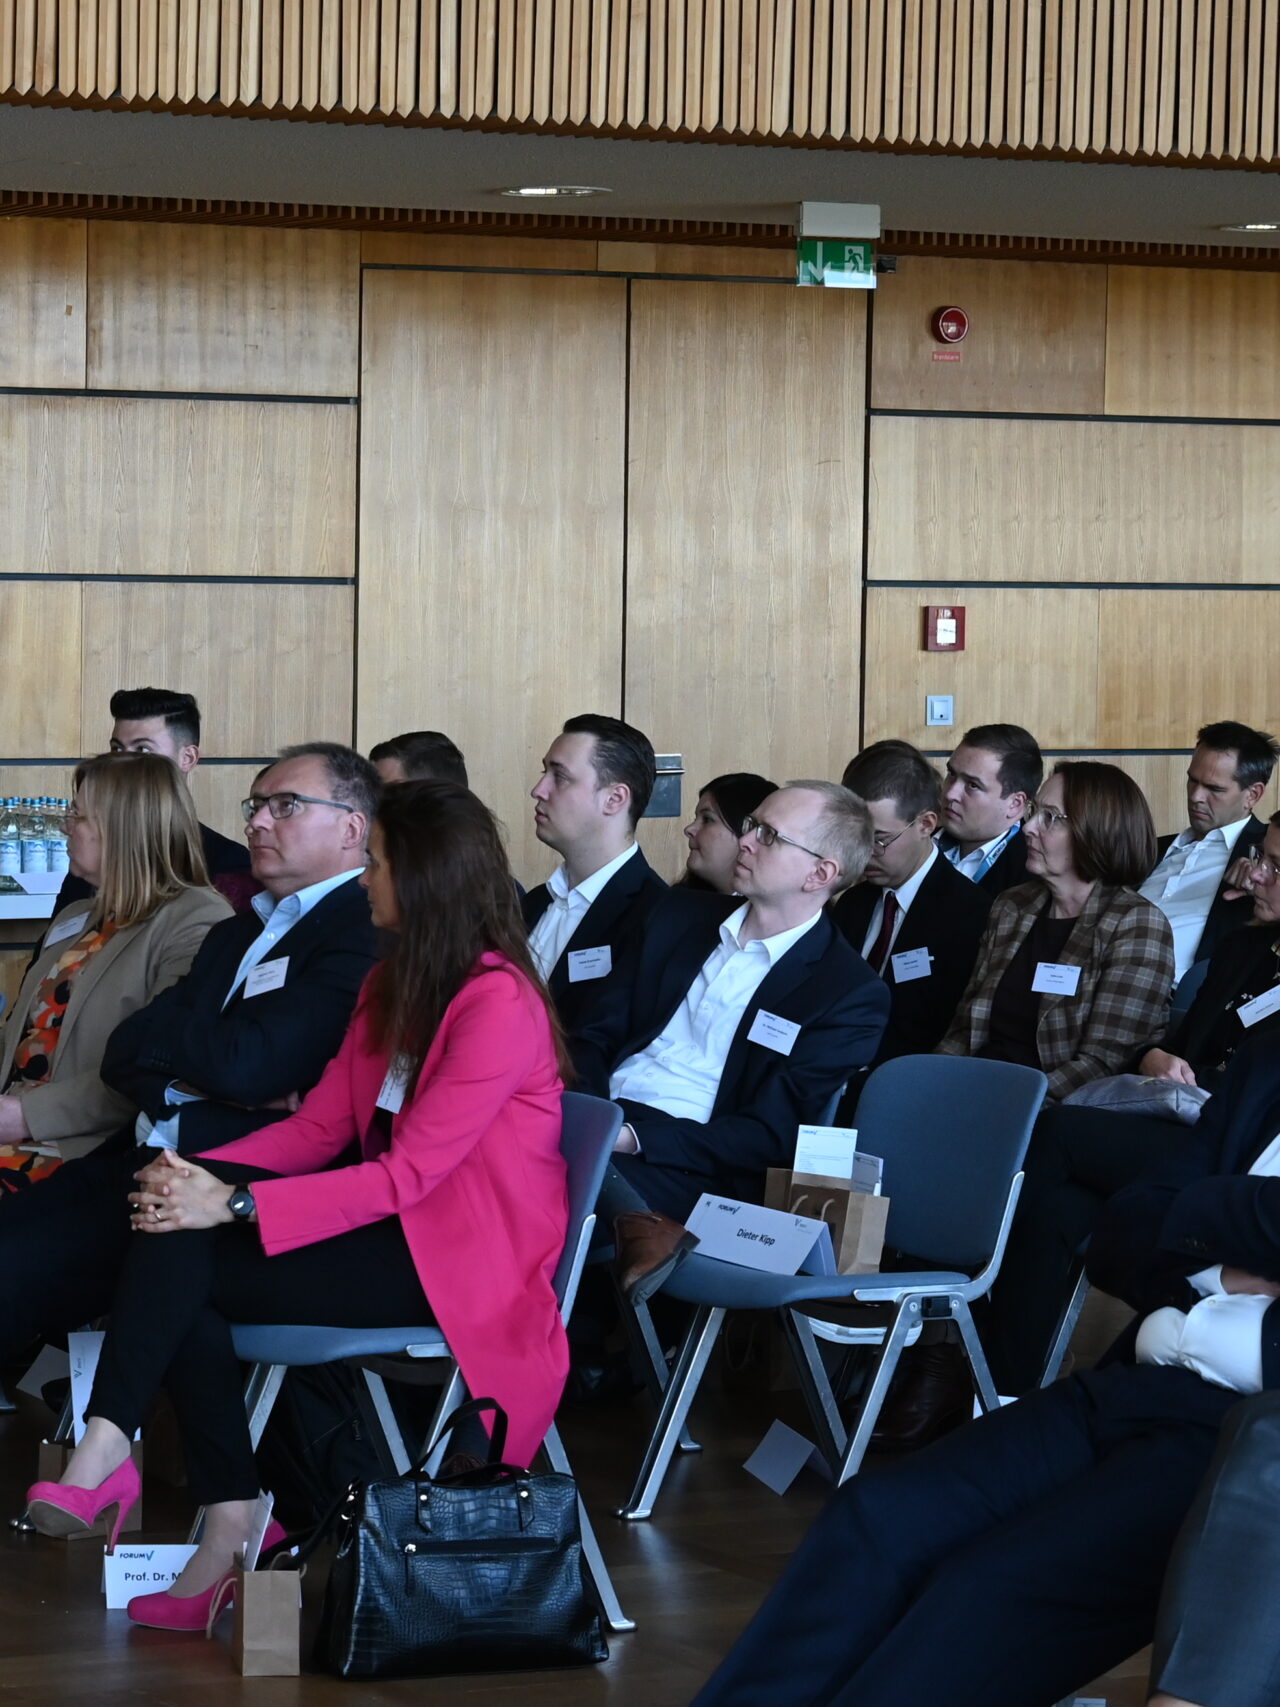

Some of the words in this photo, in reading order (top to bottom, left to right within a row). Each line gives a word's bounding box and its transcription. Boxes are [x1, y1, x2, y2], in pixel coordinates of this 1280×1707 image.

[736, 1228, 759, 1241] Dieter
[759, 1234, 775, 1247] Kipp
[124, 1572, 149, 1581] Prof.
[153, 1572, 168, 1581] Dr.
